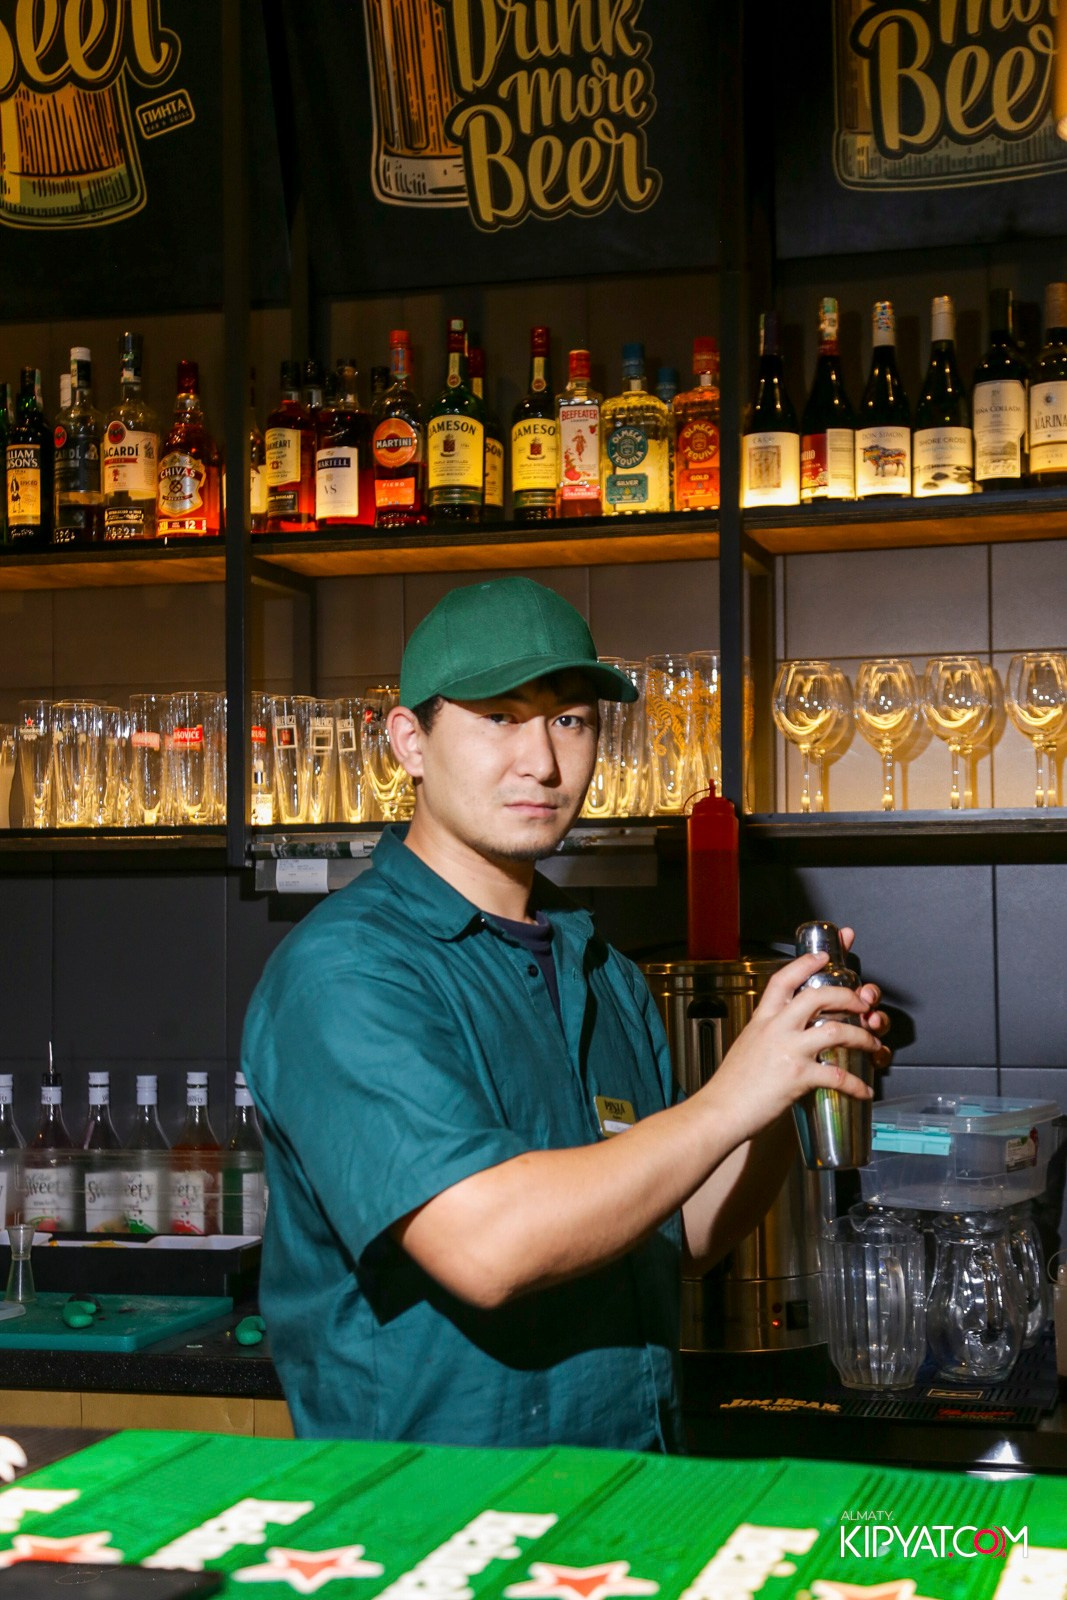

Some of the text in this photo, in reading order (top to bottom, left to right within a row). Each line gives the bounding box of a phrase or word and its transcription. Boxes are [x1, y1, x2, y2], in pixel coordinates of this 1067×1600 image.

[0, 0, 170, 84] eer
[499, 56, 647, 135] more
[142, 99, 187, 125] ПИНТА
[452, 104, 652, 222] Beer
[562, 410, 598, 420] BEEFEATER
[428, 420, 477, 439] JAMESON
[513, 423, 556, 442] JAMESO
[612, 429, 643, 444] OLMECA
[686, 423, 715, 439] OLMECA
[376, 438, 412, 449] MARTINI
[611, 450, 644, 466] TEQUILA
[684, 444, 717, 460] TEQUILA
[160, 467, 196, 479] CHIVAS
[689, 473, 710, 481] GOLD
[616, 478, 639, 486] SILVER
[184, 519, 196, 530] 12
[720, 1398, 775, 1410] JIM
[775, 1398, 842, 1414] BEAM
